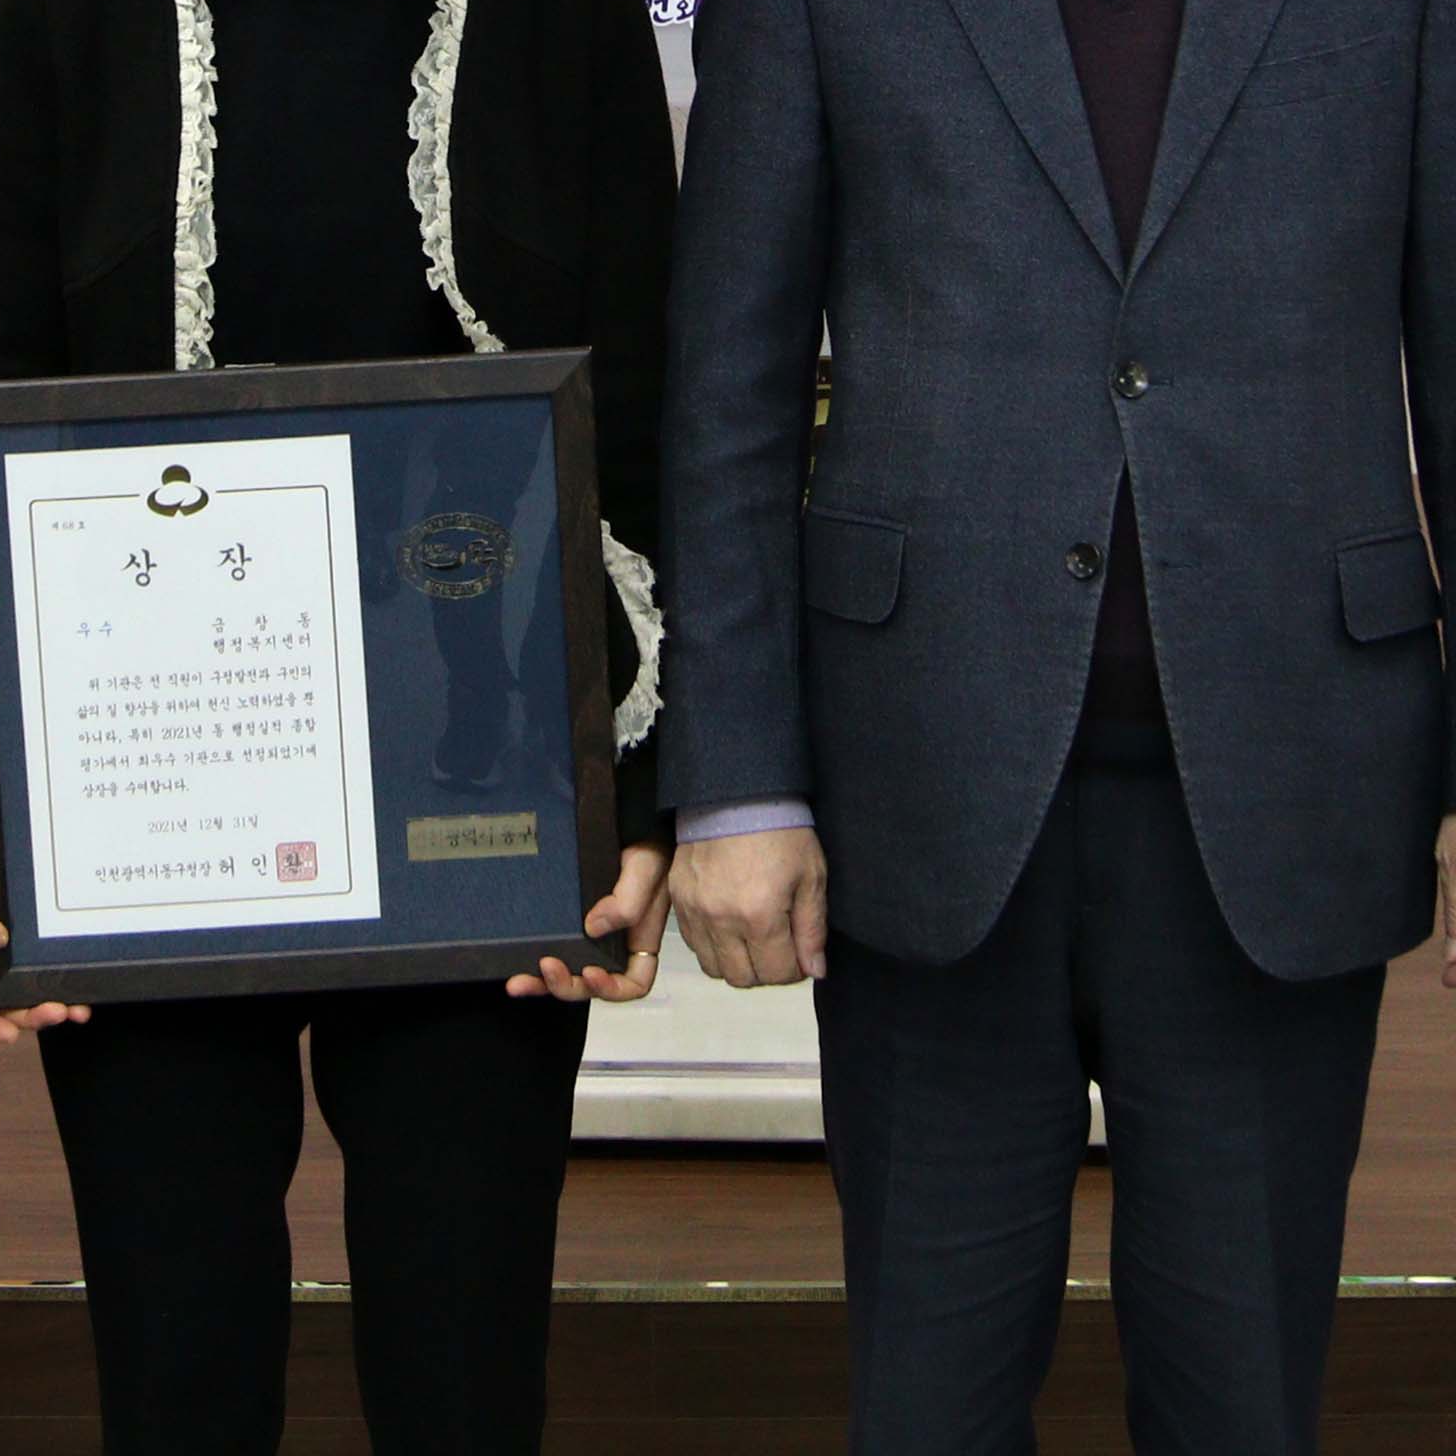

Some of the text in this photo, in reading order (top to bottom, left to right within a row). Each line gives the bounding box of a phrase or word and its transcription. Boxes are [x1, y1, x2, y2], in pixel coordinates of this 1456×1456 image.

[121, 542, 253, 587] 상 장
[161, 724, 203, 741] 2021년
[147, 818, 188, 834] 2021년
